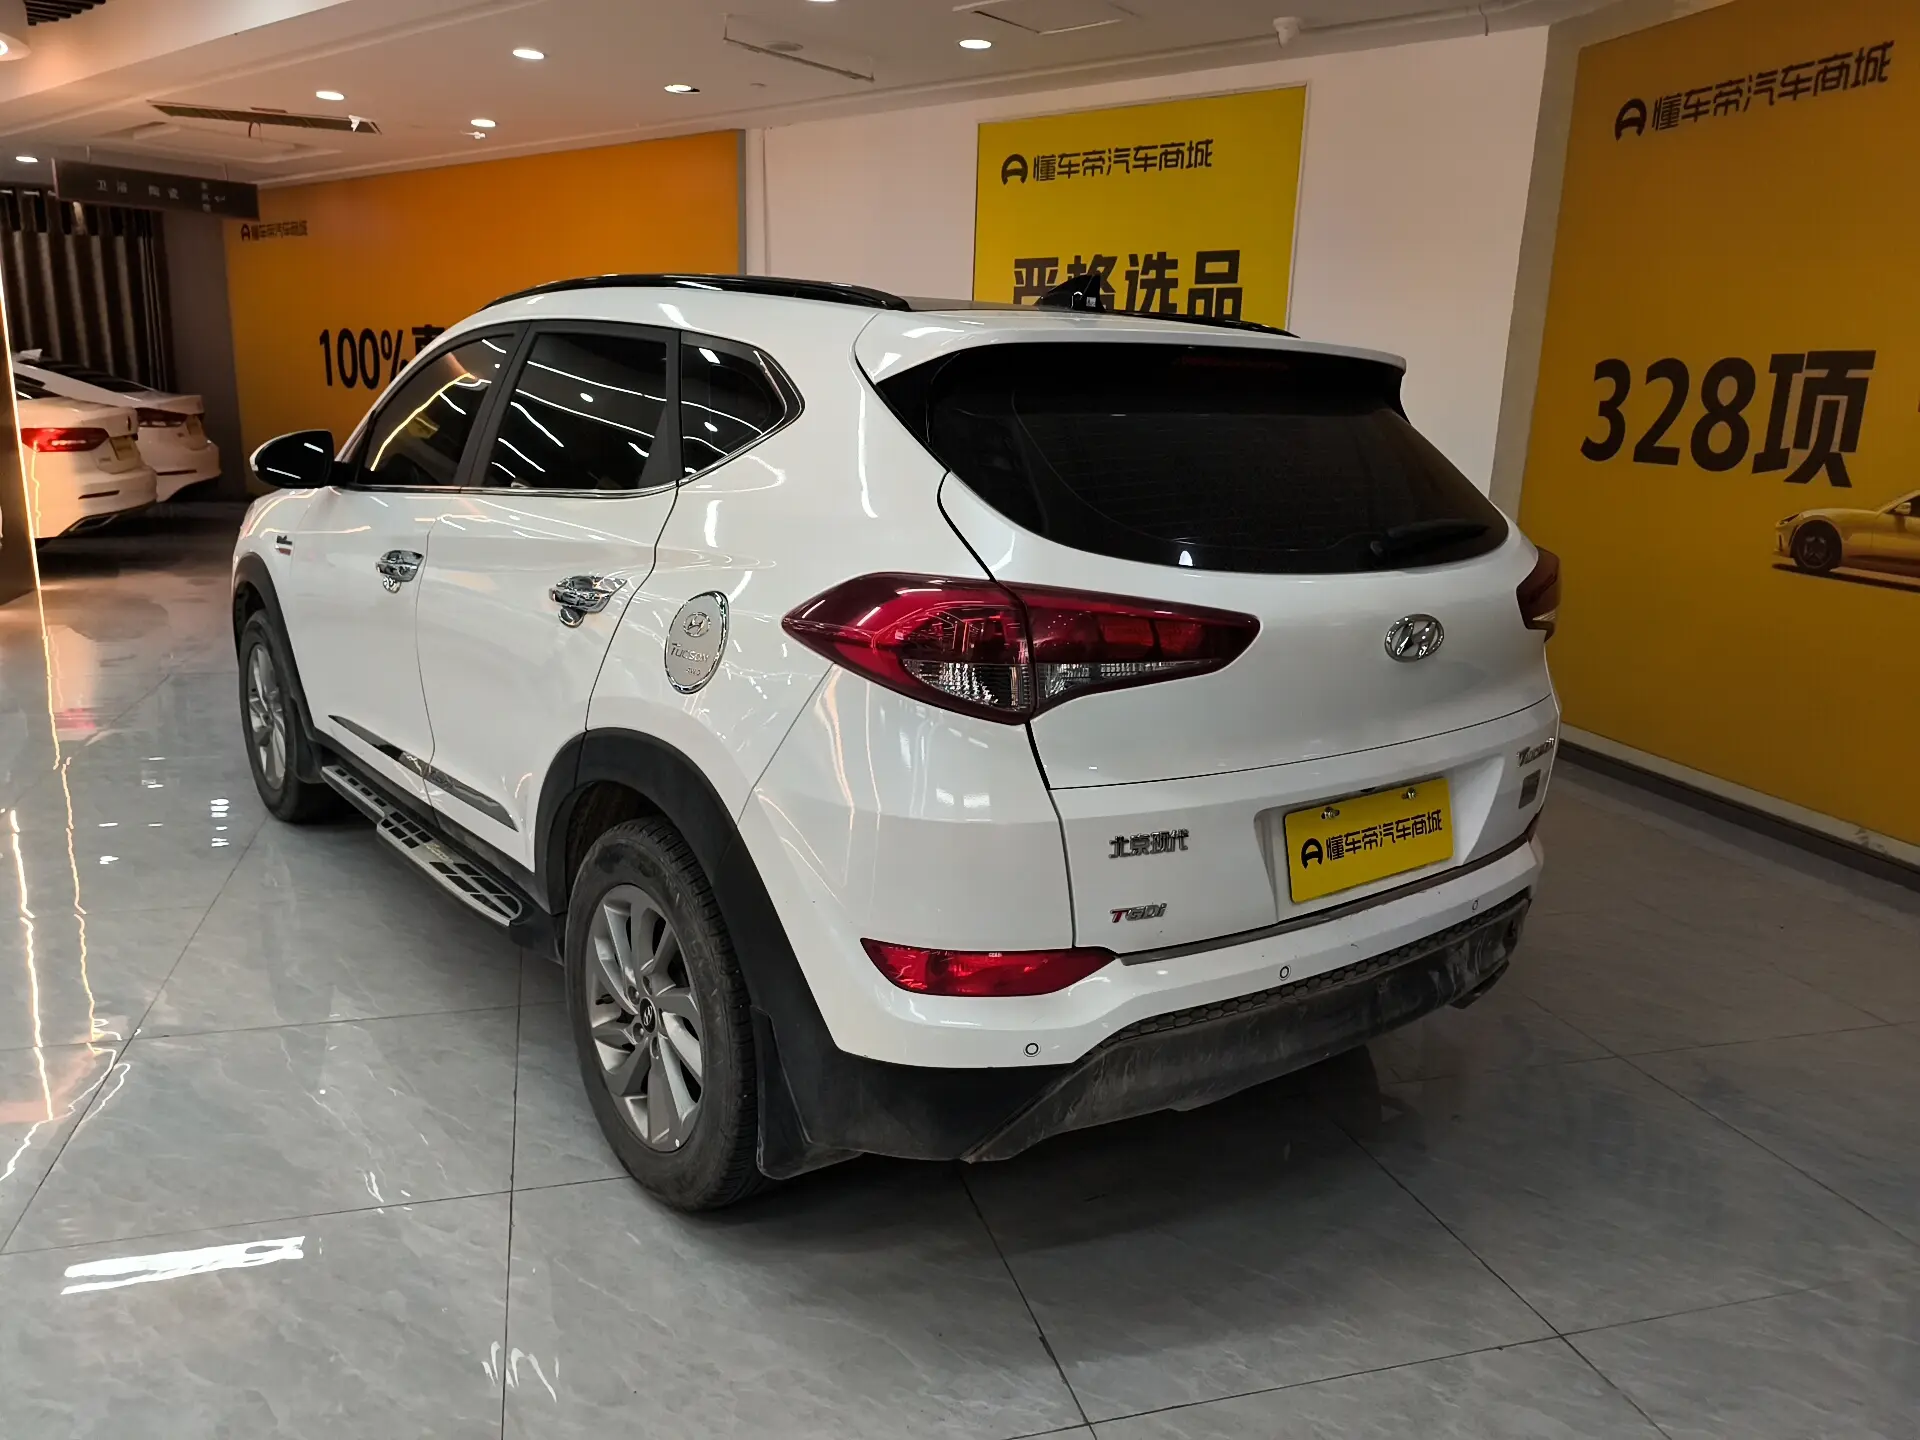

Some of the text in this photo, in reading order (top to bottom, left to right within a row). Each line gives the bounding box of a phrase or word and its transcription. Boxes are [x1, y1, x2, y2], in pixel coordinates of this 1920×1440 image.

[1652, 40, 1895, 131] 懂车帝汽车商城
[1033, 138, 1214, 182] 懂车帝汽车商城
[1580, 349, 1876, 488] 328项
[1108, 828, 1189, 859] 北京现代
[1325, 808, 1443, 863] 懂车帝汽车商城
